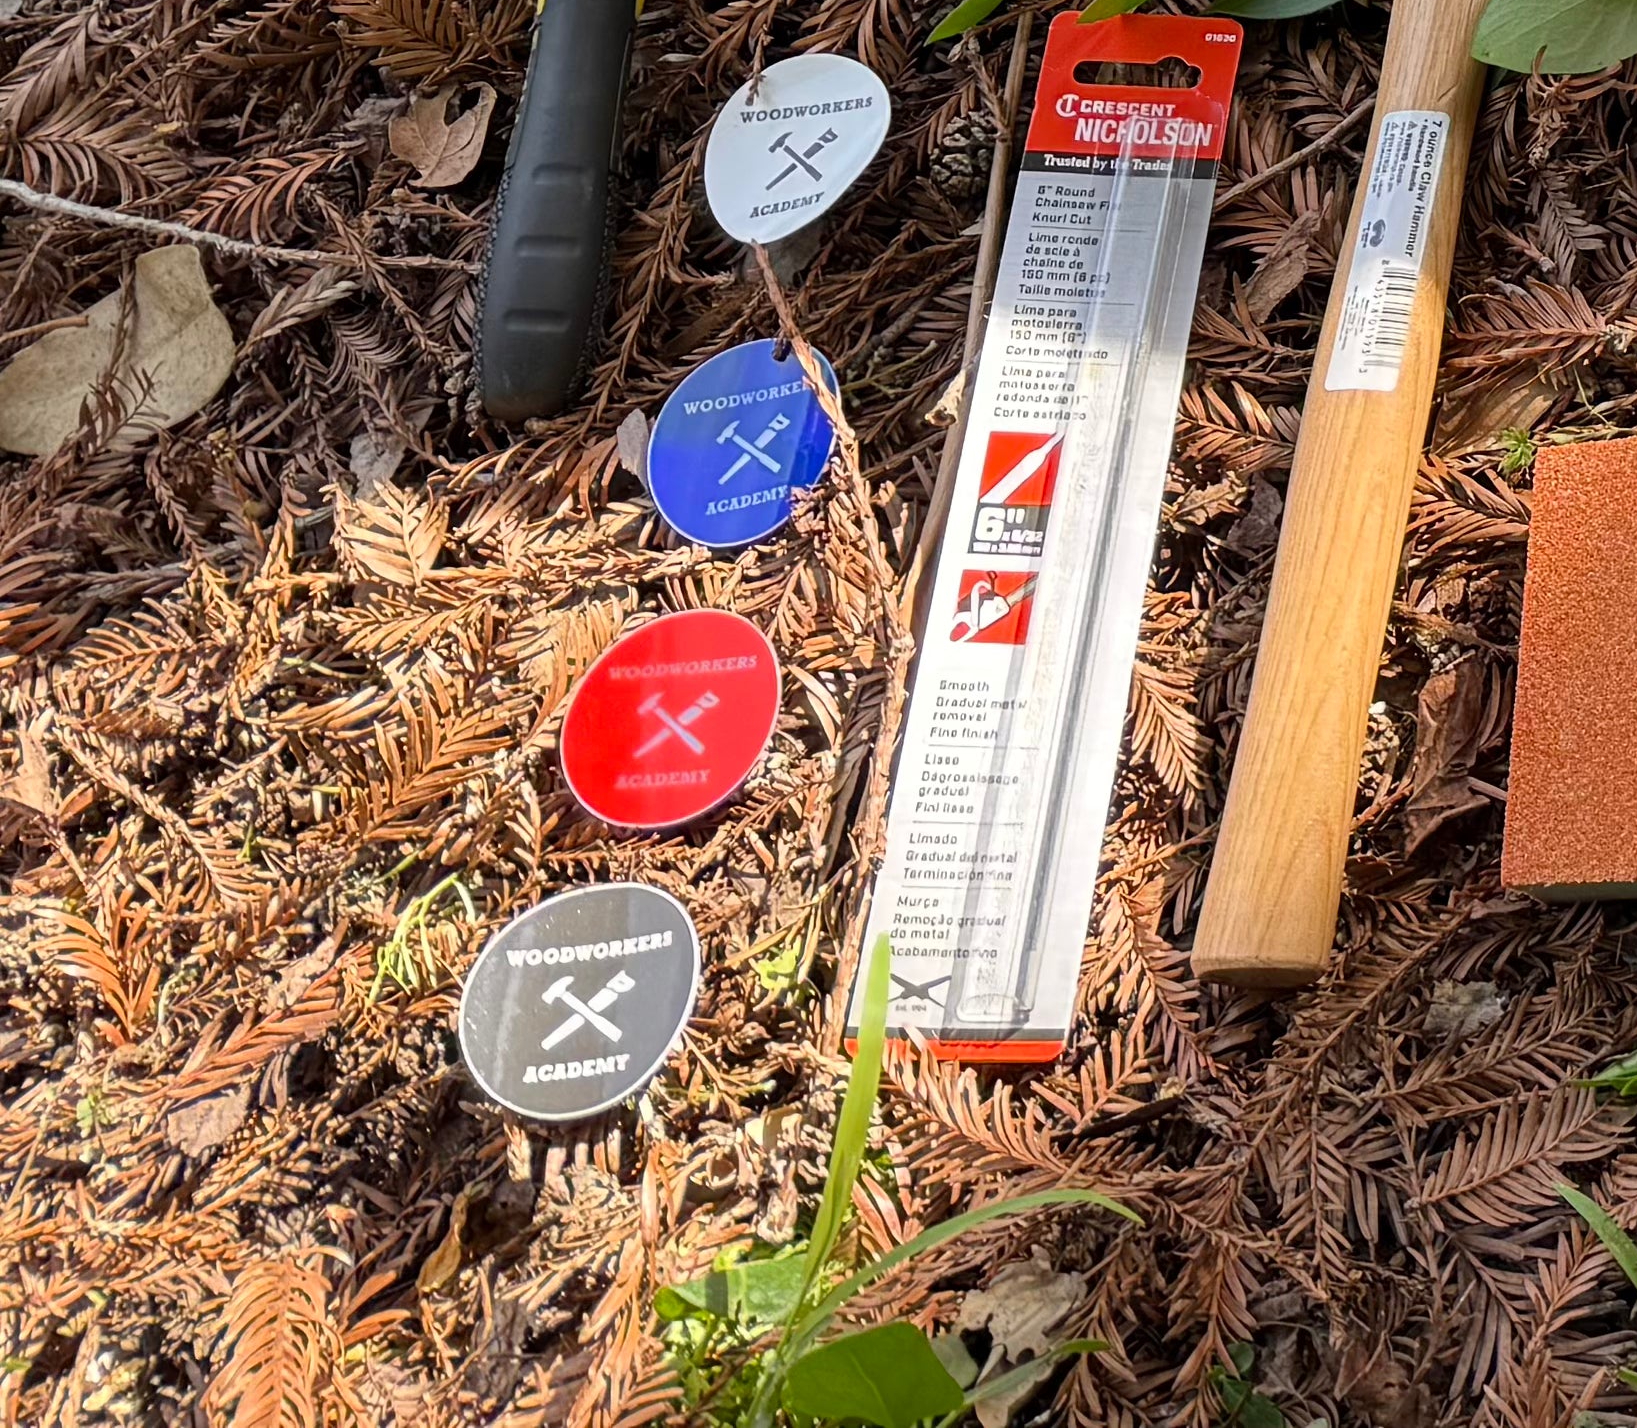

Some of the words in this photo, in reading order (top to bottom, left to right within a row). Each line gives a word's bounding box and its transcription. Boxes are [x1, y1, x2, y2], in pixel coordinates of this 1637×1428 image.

[740, 96, 873, 124] WOODWORKERS
[1080, 102, 1175, 116] CRESCENT
[1075, 118, 1212, 145] NICHOLSON
[1044, 155, 1090, 169] Trusted
[1423, 130, 1437, 168] ounce
[1417, 172, 1432, 203] Claw
[750, 191, 825, 219] ACADEMY
[1033, 212, 1066, 224] Knurl
[1070, 214, 1091, 225] Cut
[1405, 204, 1425, 257] Hammer
[683, 380, 812, 415] WOODWORKE
[705, 484, 789, 515] ACADEMY
[608, 655, 758, 681] WOODWORKERS
[615, 770, 710, 790] ACADEMY
[506, 931, 673, 967] WOODWORKERS
[523, 1054, 630, 1083] ACADEMY
